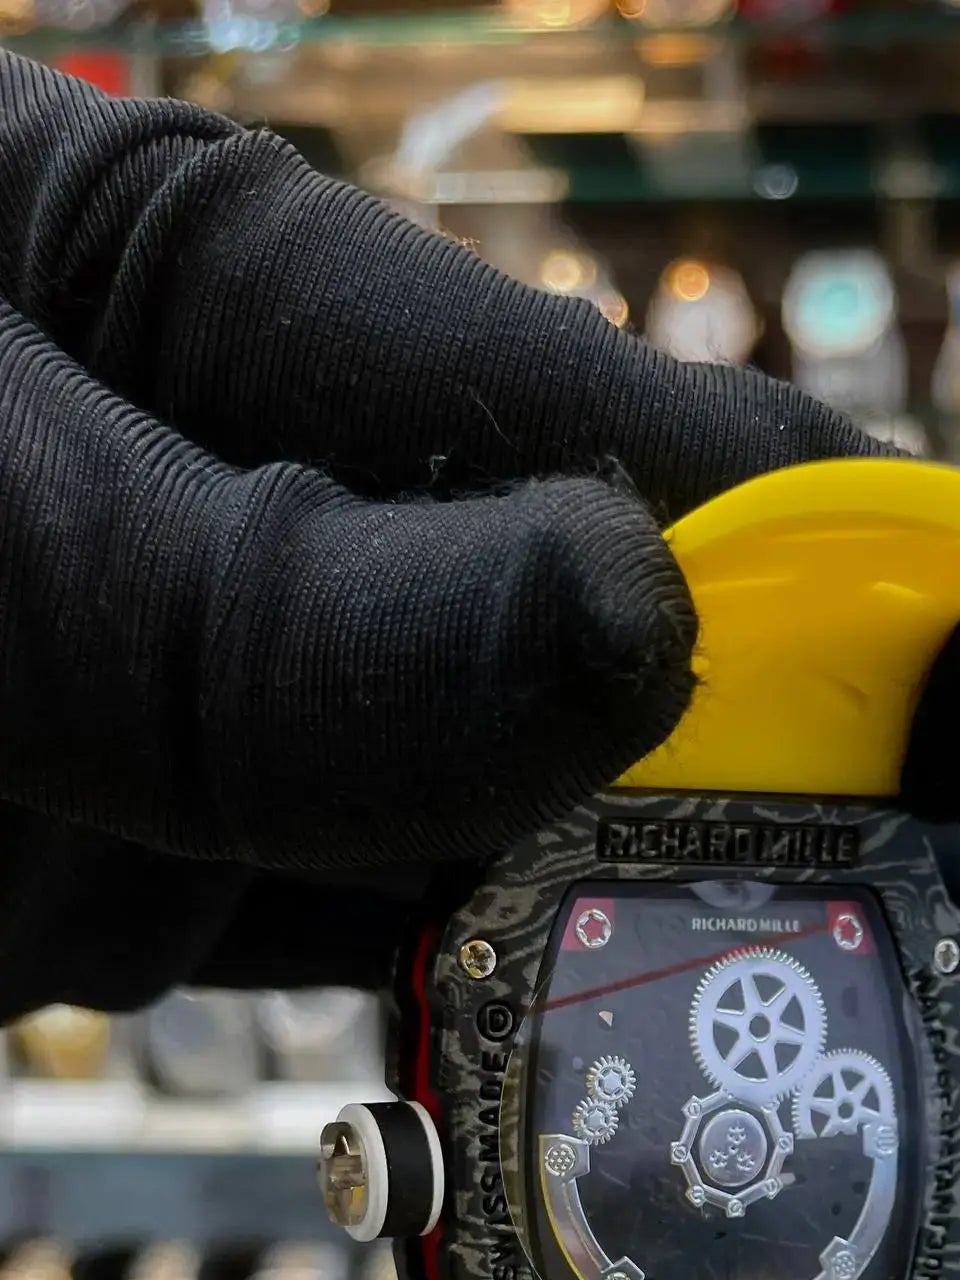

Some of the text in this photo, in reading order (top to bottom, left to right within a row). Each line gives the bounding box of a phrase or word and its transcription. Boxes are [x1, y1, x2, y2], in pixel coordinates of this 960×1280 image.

[603, 823, 855, 863] RICHARD MILLE
[692, 917, 801, 933] RICHARD MILLE
